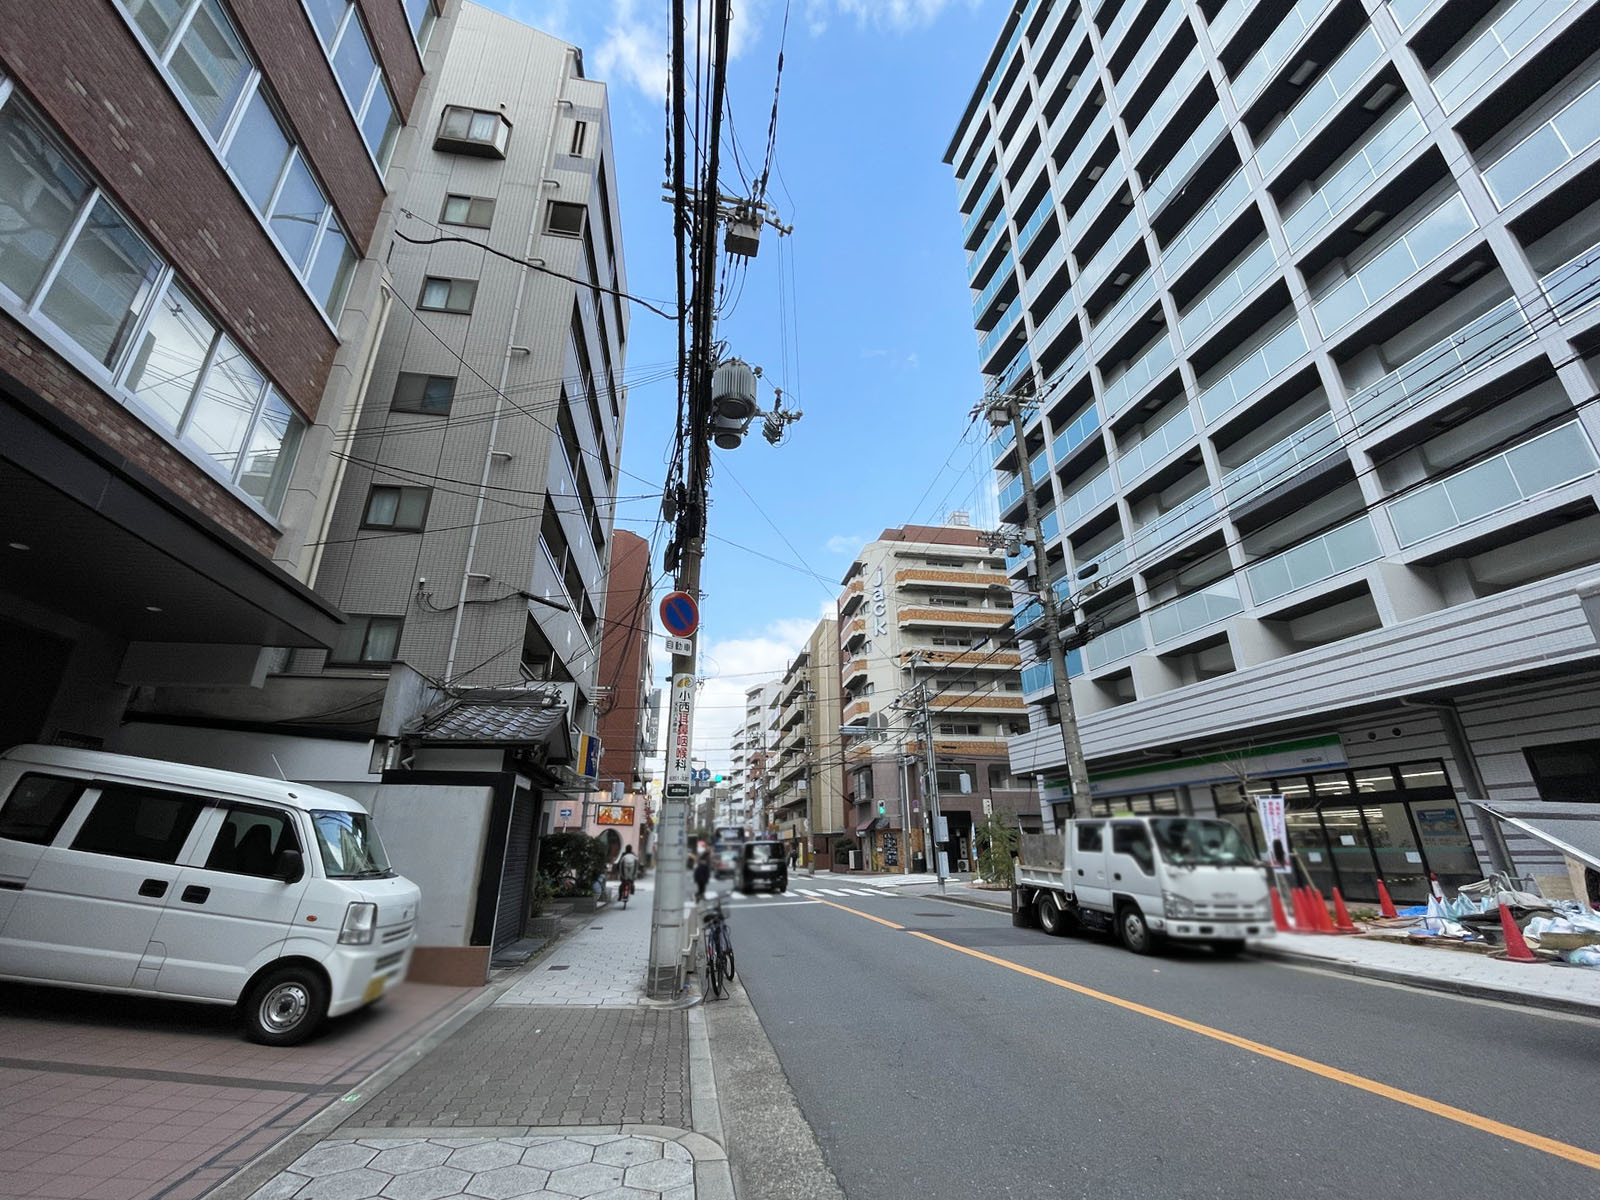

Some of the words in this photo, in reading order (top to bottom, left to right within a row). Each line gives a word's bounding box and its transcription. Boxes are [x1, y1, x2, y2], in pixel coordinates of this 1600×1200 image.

[666, 640, 690, 652] 自動車
[675, 691, 690, 771] 小西耳鼻咽喉科
